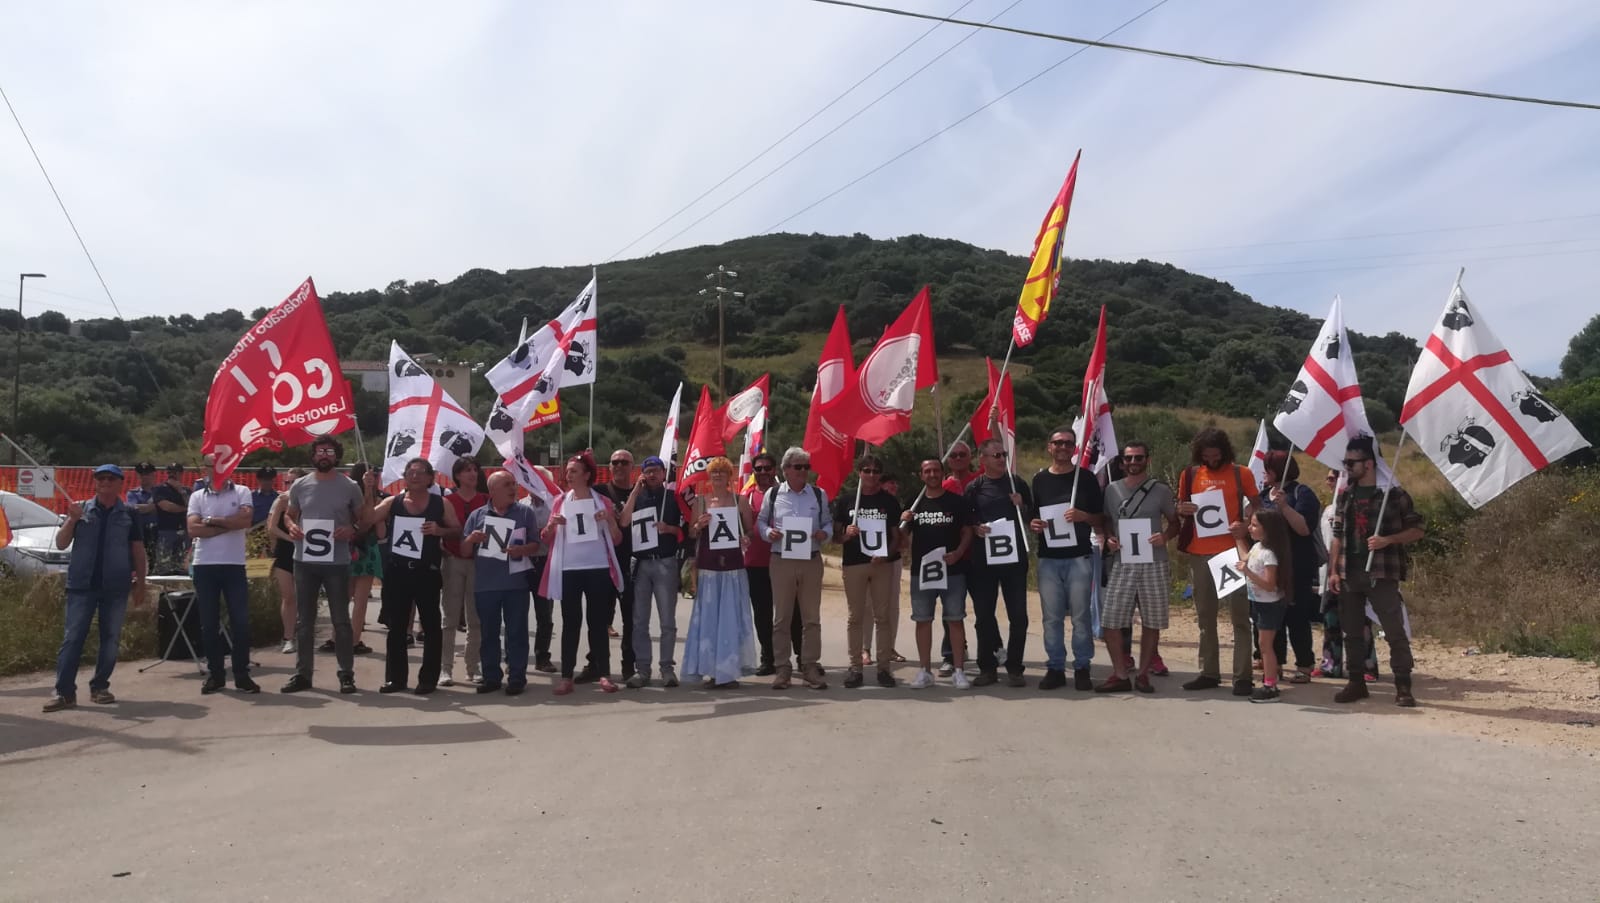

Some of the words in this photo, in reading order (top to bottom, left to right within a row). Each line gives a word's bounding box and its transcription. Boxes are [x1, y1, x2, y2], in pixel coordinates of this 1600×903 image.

[1013, 317, 1033, 343] BASE
[576, 513, 587, 536] I
[711, 512, 737, 543] À
[919, 514, 954, 526] popolo!
[1196, 504, 1225, 529] C
[394, 530, 420, 551] A
[480, 524, 513, 554] N
[632, 514, 655, 544] T
[785, 529, 808, 552] P
[860, 530, 883, 551] U
[1046, 518, 1071, 540] L
[304, 528, 333, 557] S
[988, 535, 1014, 558] B
[1130, 532, 1141, 556] I
[921, 560, 944, 584] B
[1218, 563, 1243, 592] A
